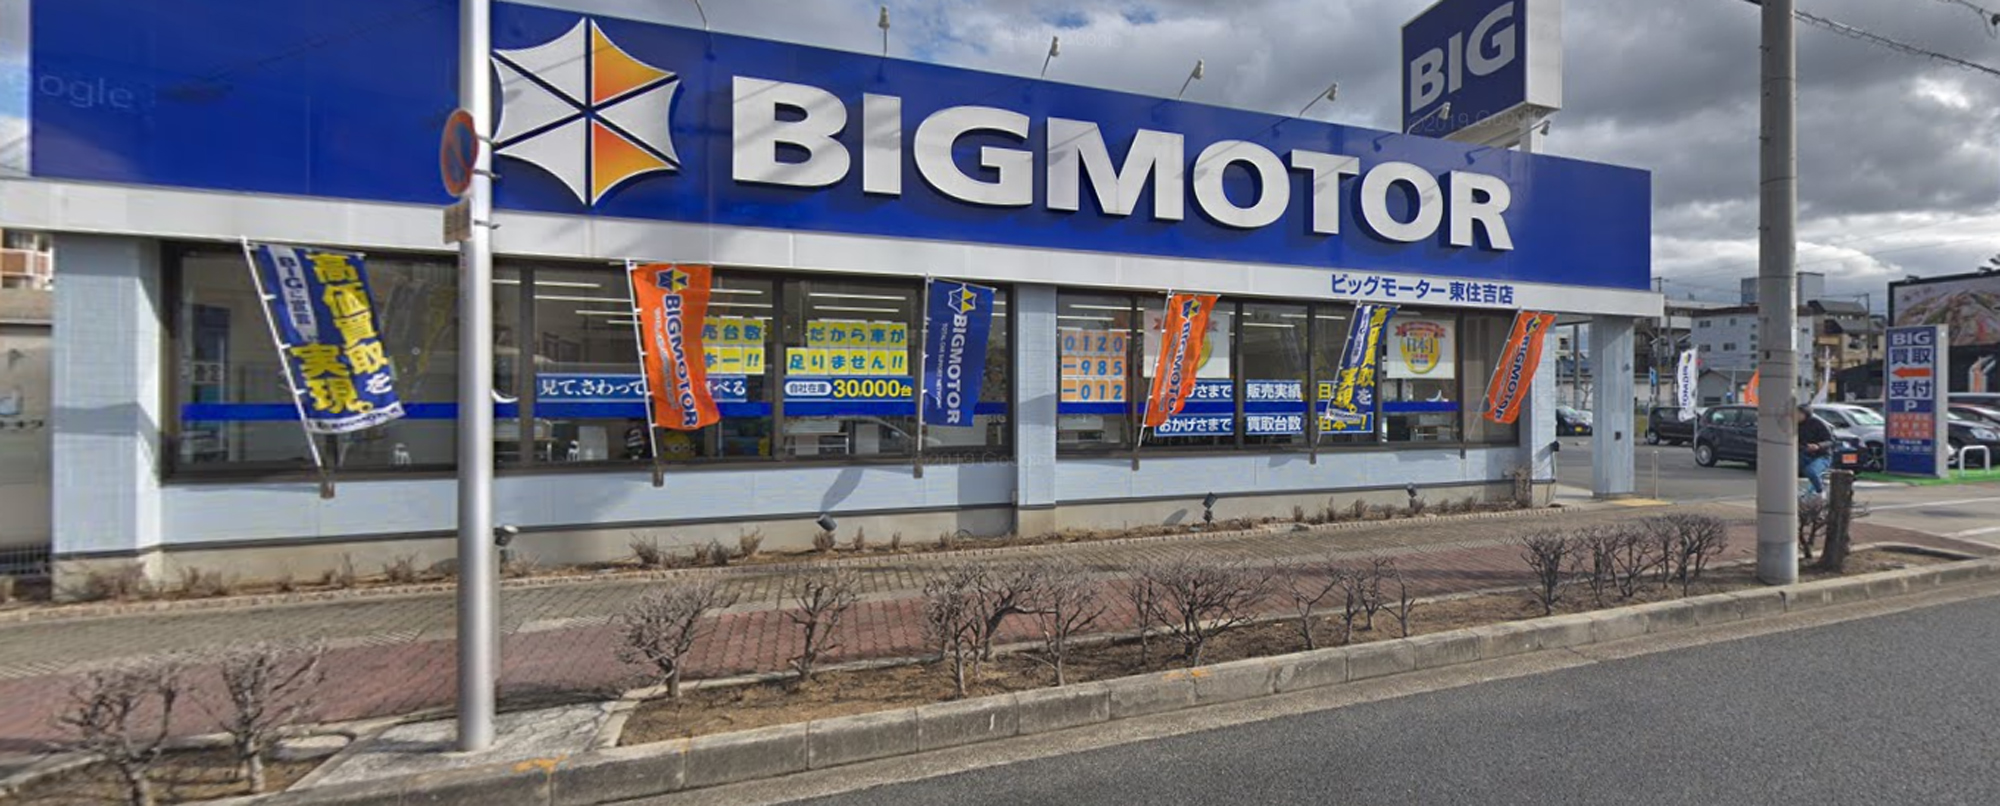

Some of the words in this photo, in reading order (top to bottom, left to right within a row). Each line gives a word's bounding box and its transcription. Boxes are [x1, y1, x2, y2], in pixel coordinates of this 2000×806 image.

[1410, 1, 1515, 113] BIG
[732, 76, 1514, 251] BIGMOTOR
[810, 327, 905, 343] だから車が
[1064, 335, 1123, 352] 0120
[1892, 331, 1931, 346] BIG
[663, 294, 698, 428] BIGMOTOR
[1891, 348, 1931, 365] 買取
[947, 313, 968, 424] BIGMOTOR
[1247, 384, 1301, 398] 販売実績
[1890, 380, 1932, 398] 受付
[1904, 401, 1918, 412] P
[1159, 418, 1232, 432] おかげさまで
[1247, 416, 1301, 431] 買取台数
